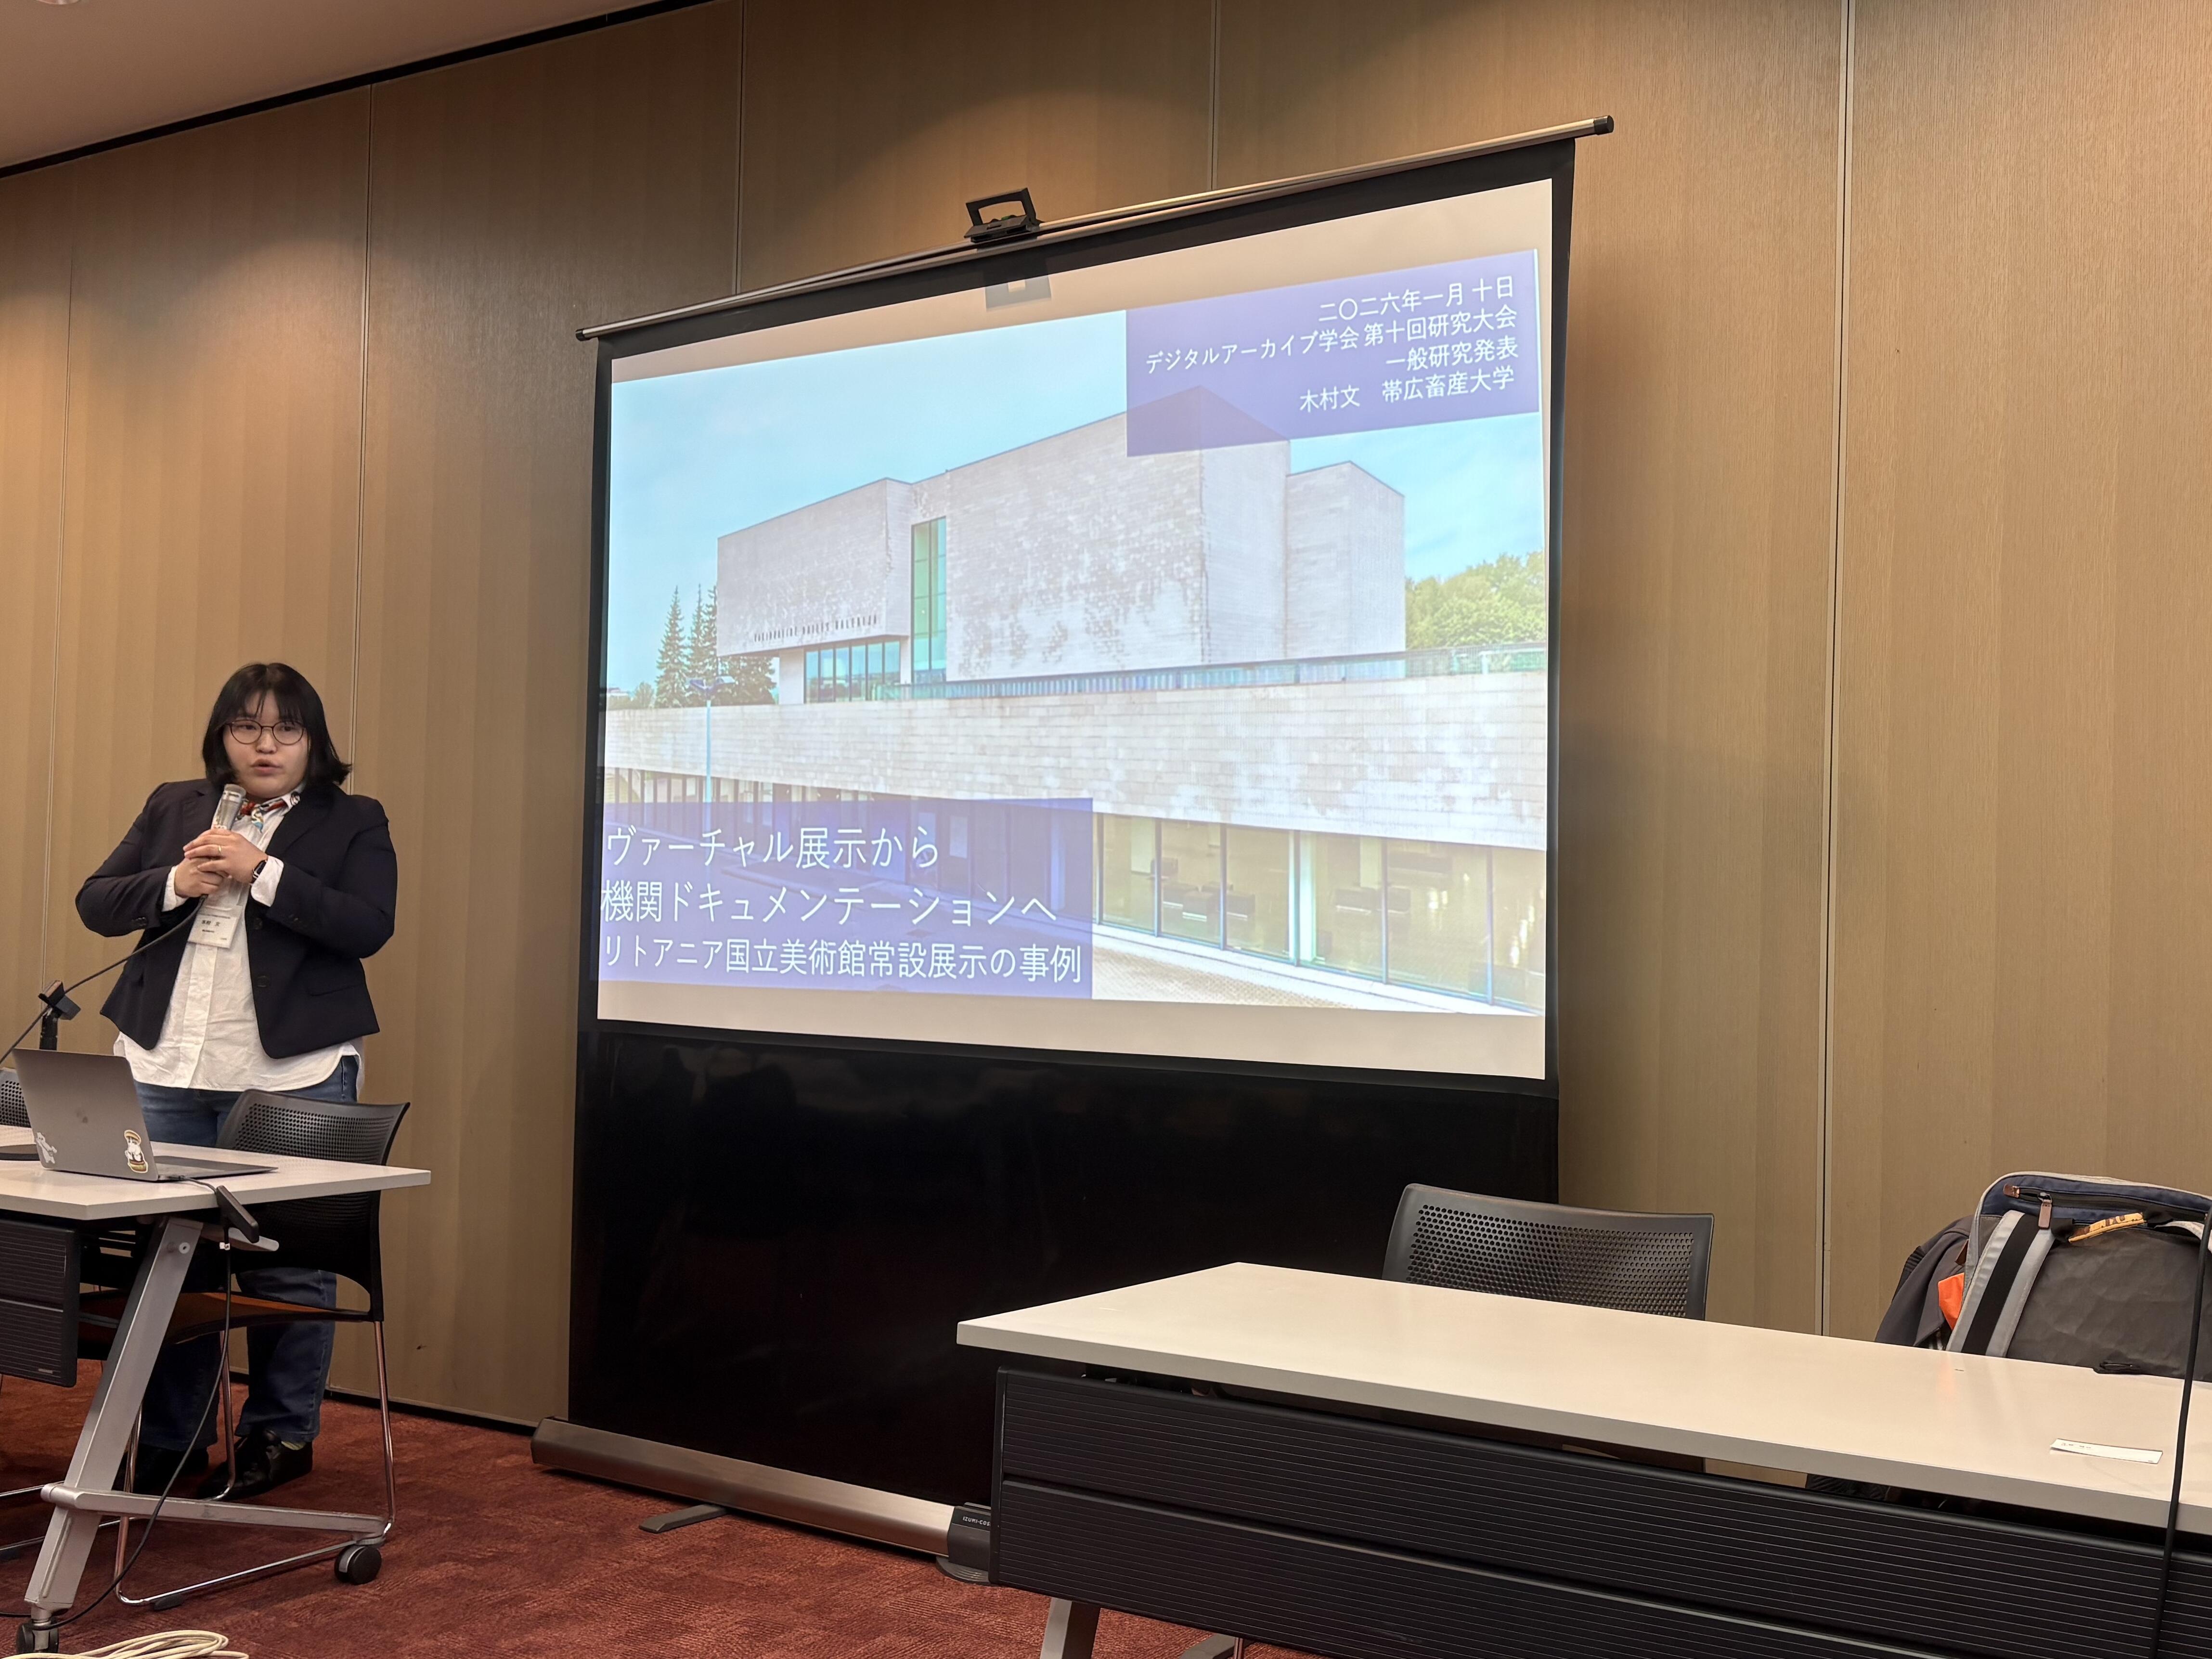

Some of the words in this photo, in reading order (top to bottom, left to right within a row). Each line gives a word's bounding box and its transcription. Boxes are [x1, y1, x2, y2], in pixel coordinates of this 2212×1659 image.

[1385, 335, 1519, 371] 一般研究発表
[1299, 384, 1360, 413] 木村文
[1382, 365, 1514, 403] 帯広畜産大学
[607, 824, 938, 869] ヴァーチャル展示から
[600, 879, 1057, 927] 機関ドキュメンテーションへ
[606, 935, 1081, 983] リトアニア国立美術館常設展示の事例
[962, 1516, 991, 1527] IZUMI-COS
